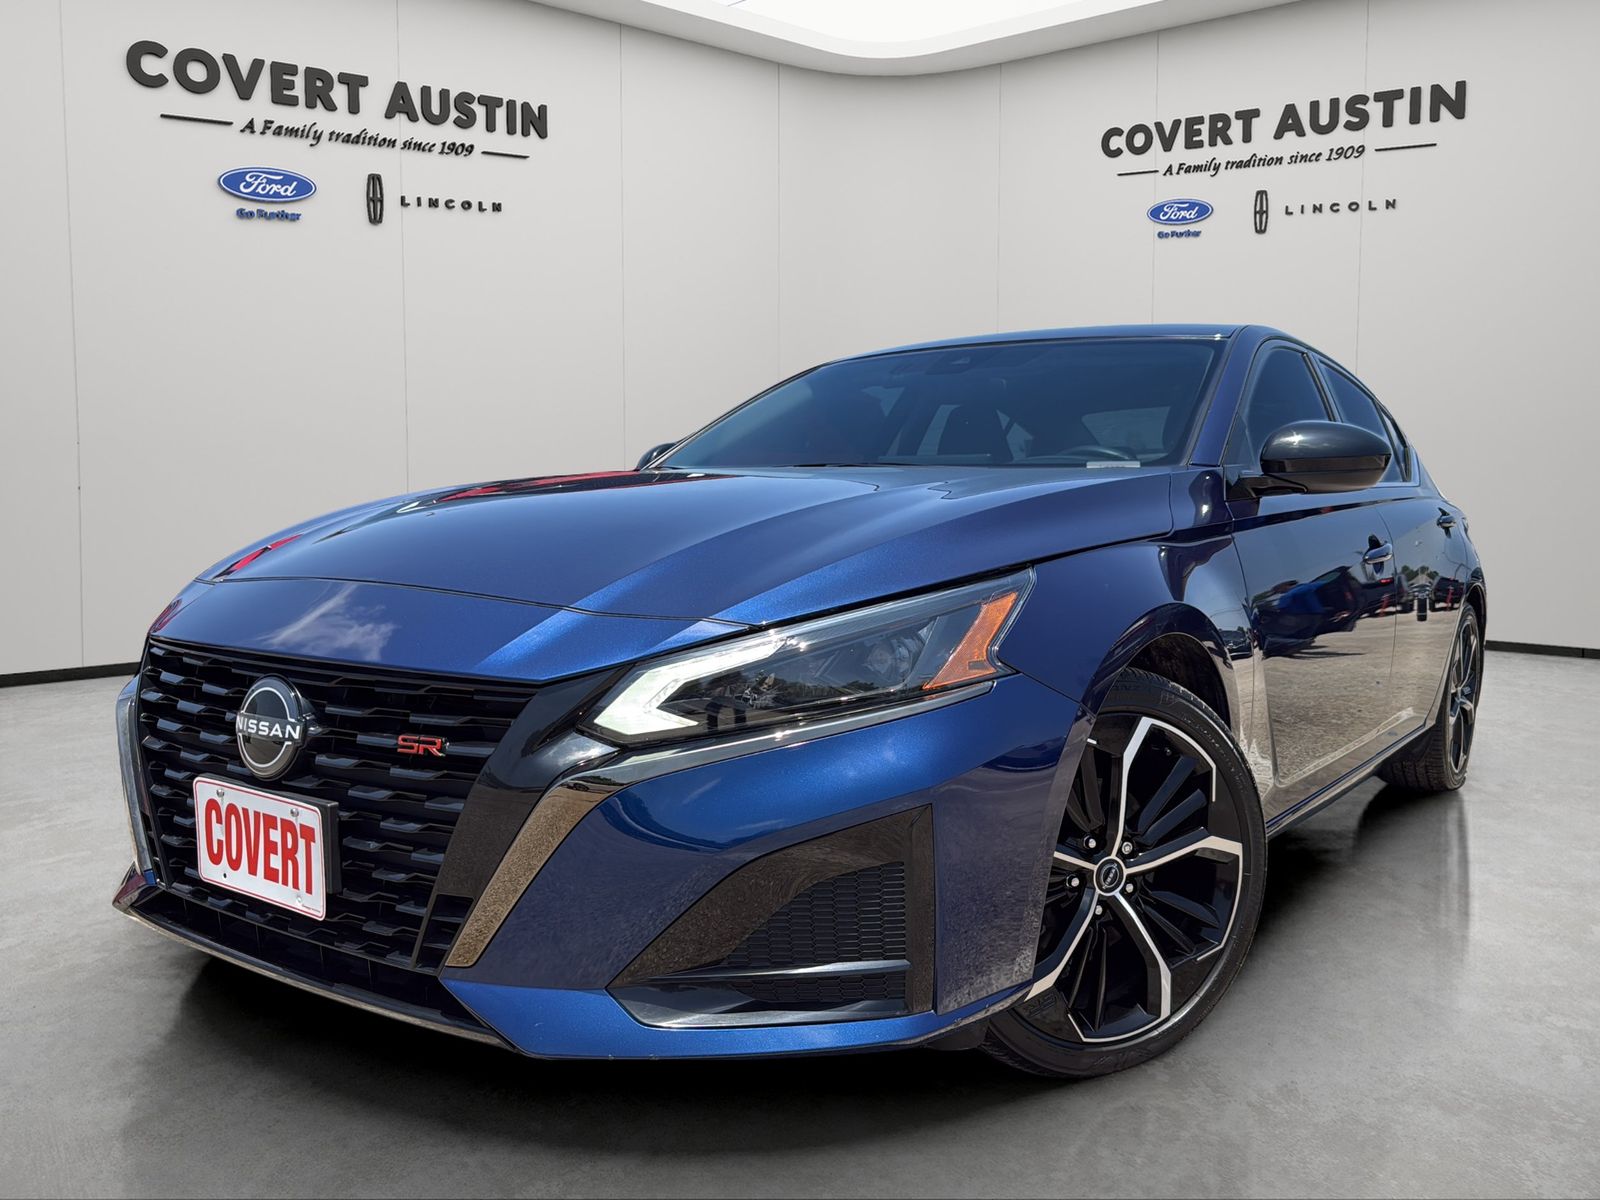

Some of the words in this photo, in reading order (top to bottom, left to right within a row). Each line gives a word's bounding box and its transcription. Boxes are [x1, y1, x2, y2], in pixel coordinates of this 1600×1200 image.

[125, 40, 369, 116] COVERT
[384, 80, 548, 140] AUSTIN
[1100, 107, 1261, 159] COVERT
[1272, 79, 1467, 141] AUSTIN
[239, 117, 257, 135] A
[259, 118, 324, 148] Family
[327, 127, 398, 150] tradition
[399, 136, 438, 154] since
[438, 140, 476, 158] 1909
[1162, 163, 1174, 177] A
[1175, 156, 1222, 178] Family
[1224, 152, 1284, 171] tradition
[1287, 151, 1323, 166] since
[1325, 144, 1366, 162] 1909
[239, 171, 298, 197] Ford
[235, 207, 256, 220] Go
[400, 195, 503, 213] LINCOLN
[1159, 202, 1200, 220] Ford
[1284, 198, 1397, 216] LINCOLN
[1157, 230, 1170, 239] Go
[236, 714, 300, 740] NISSAN
[397, 734, 446, 758] SR
[204, 797, 316, 896] COVERT
